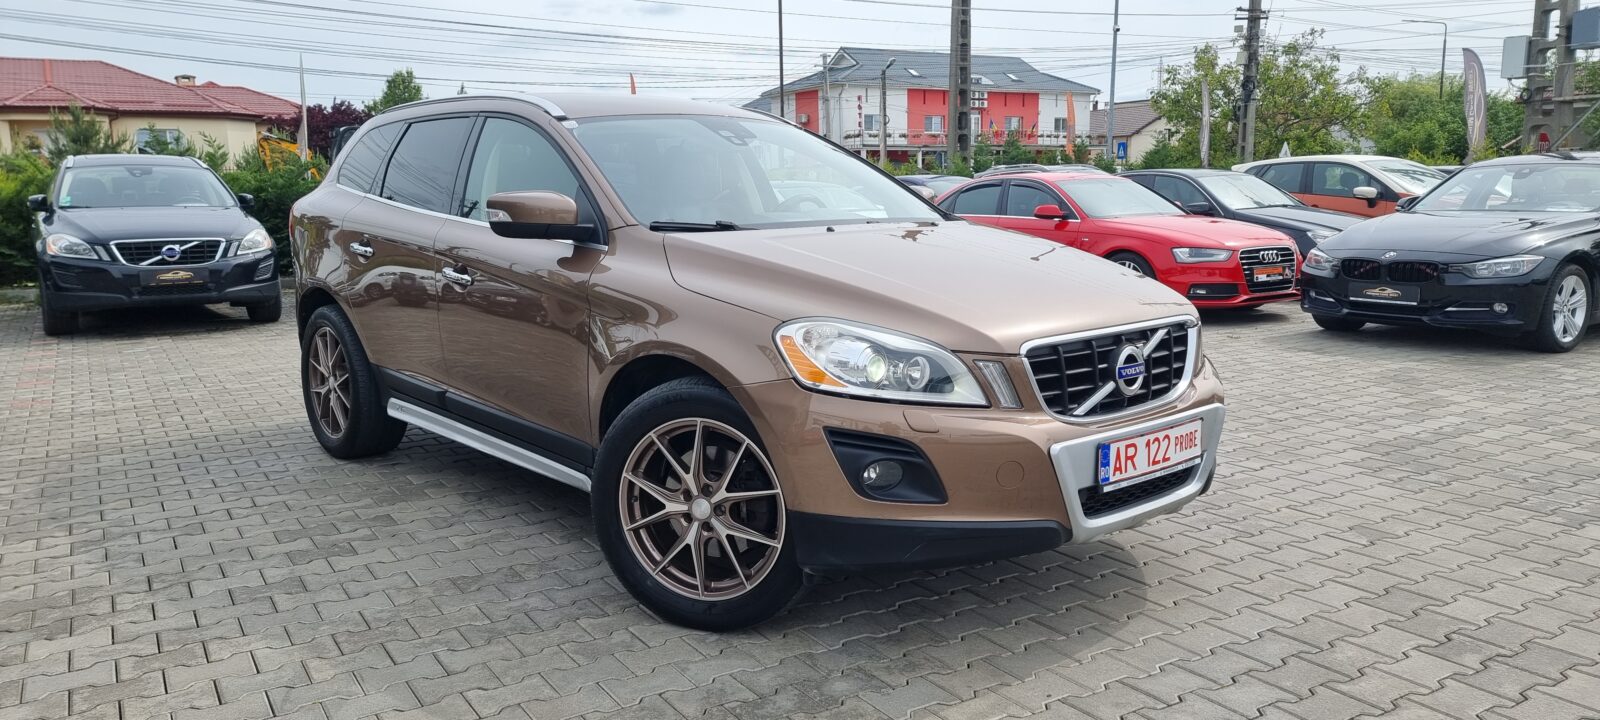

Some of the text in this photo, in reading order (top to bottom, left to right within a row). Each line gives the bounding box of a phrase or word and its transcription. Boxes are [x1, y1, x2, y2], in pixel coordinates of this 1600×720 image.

[1120, 366, 1145, 376] VOLVO
[1112, 442, 1138, 477] AR
[1145, 433, 1171, 468] 122
[1174, 429, 1198, 454] PROBE
[1100, 467, 1110, 479] RO
